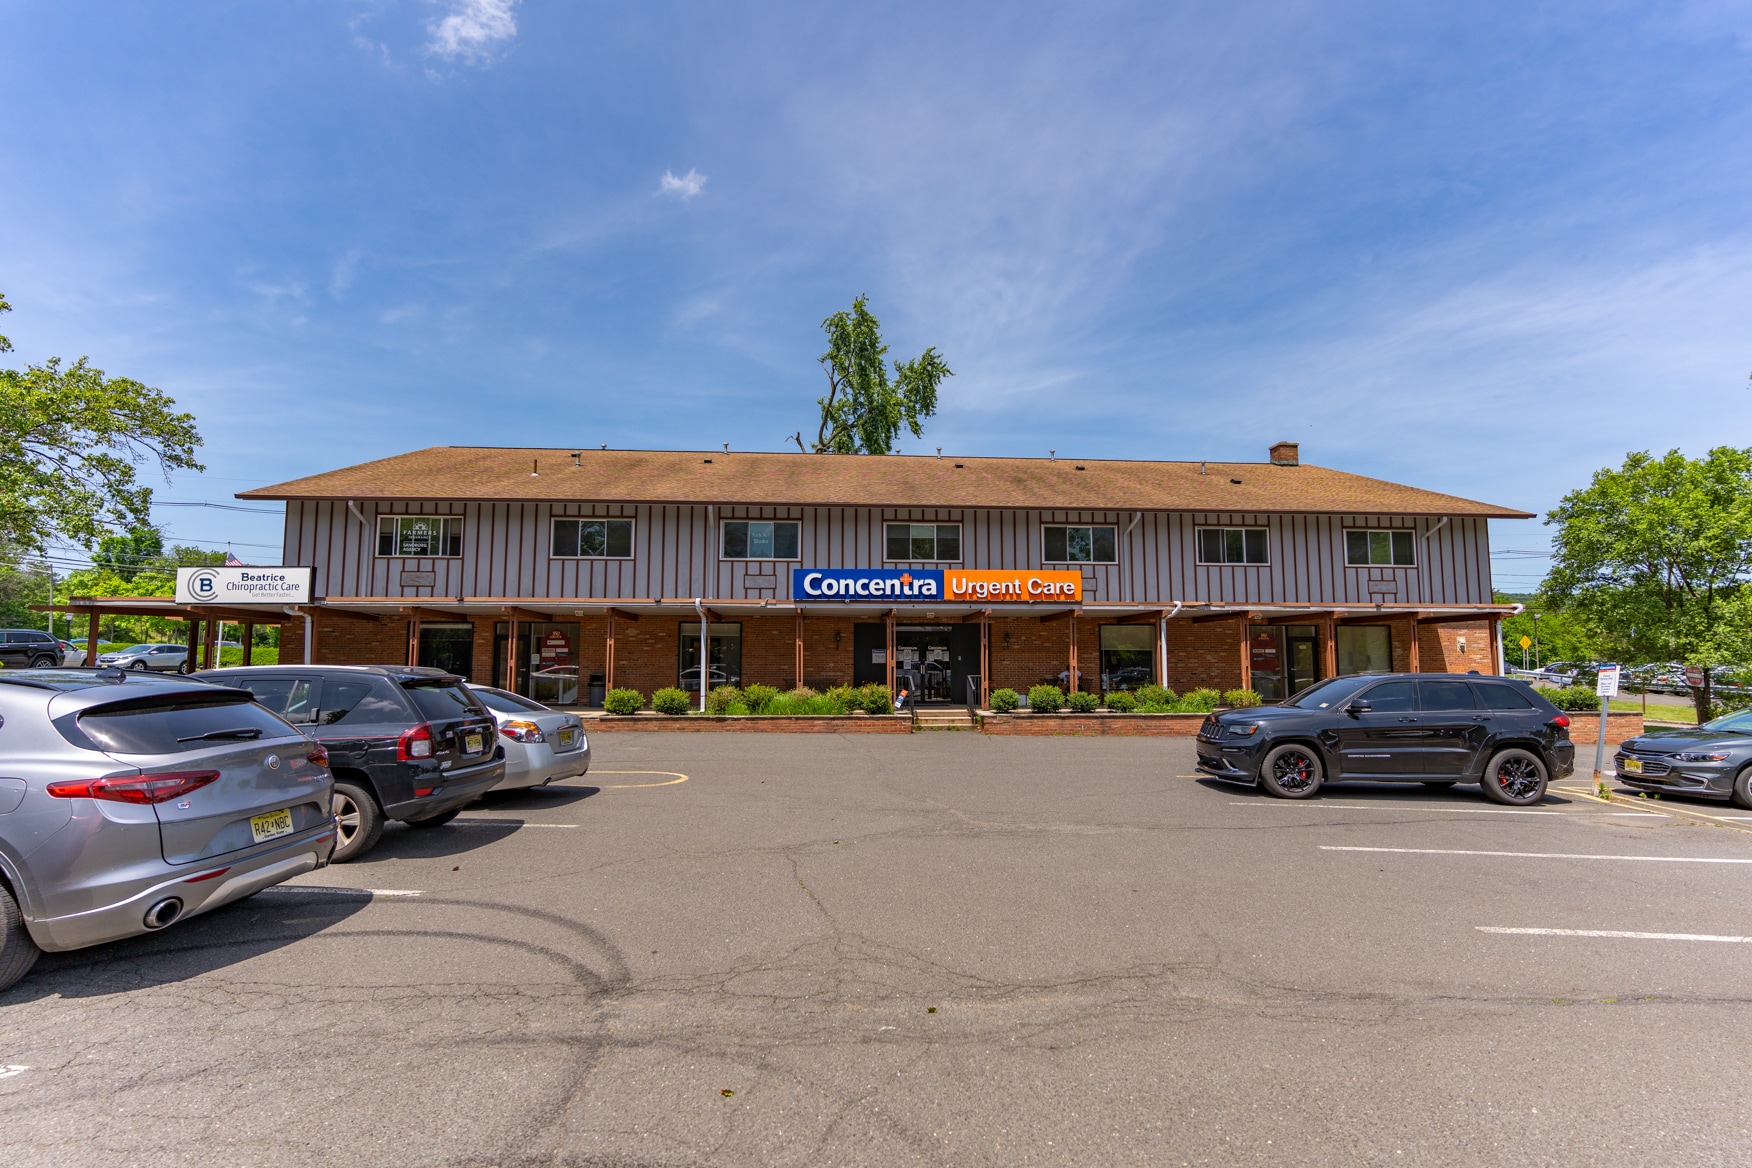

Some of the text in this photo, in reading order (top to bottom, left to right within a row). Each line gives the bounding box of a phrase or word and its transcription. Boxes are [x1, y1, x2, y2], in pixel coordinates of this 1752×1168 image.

[241, 572, 286, 582] Beatrice
[226, 582, 300, 593] Chiropractic Care
[803, 573, 1075, 598] Concentra Urgent Care
